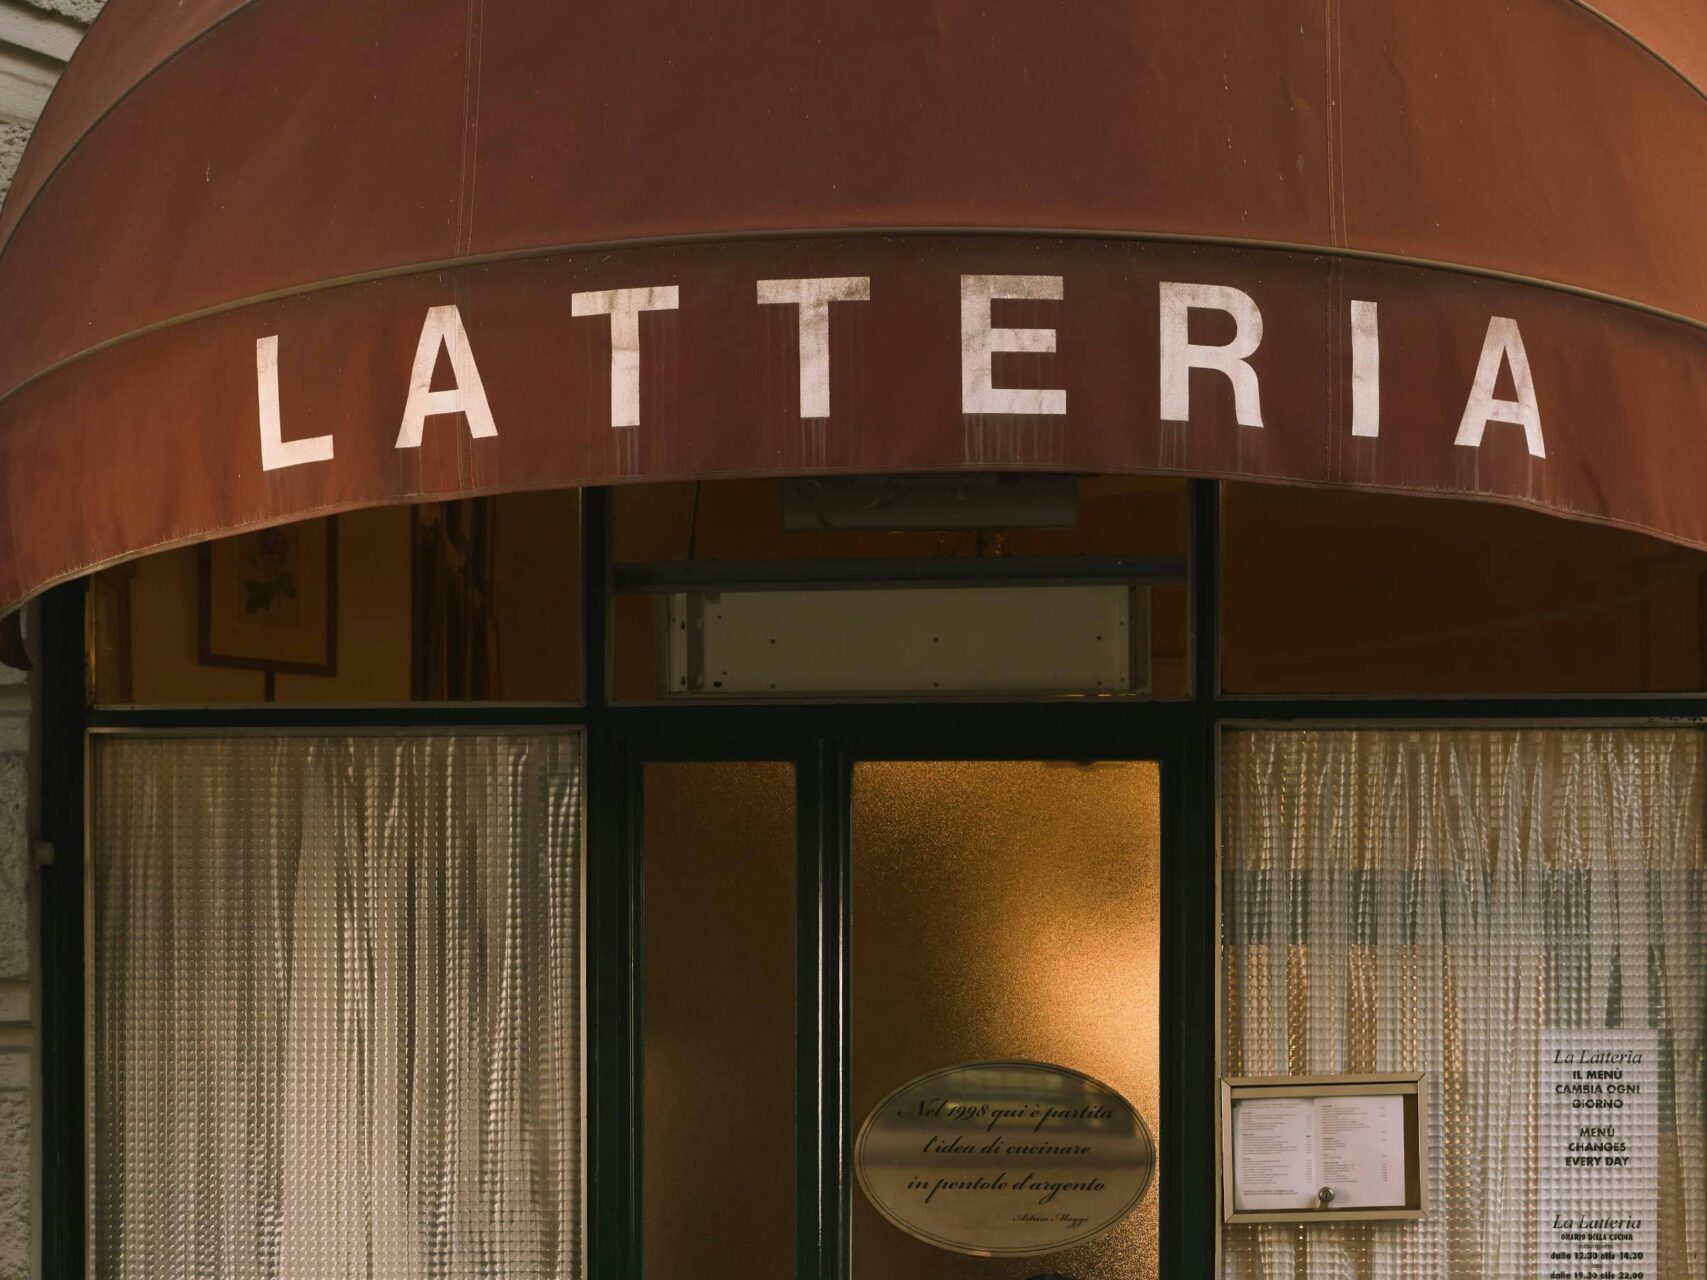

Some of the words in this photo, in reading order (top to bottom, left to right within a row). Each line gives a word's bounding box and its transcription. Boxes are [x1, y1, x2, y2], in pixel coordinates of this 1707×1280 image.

[255, 274, 1547, 472] LATTERIA
[1553, 1049, 1574, 1064] La
[1578, 1049, 1642, 1064] Latteria
[1572, 1070, 1583, 1080] IL
[1586, 1067, 1623, 1080] MENÙ
[1555, 1084, 1603, 1094] CAMBIA
[1572, 1099, 1624, 1109] GIORNO
[897, 1098, 949, 1118] Nel
[947, 1102, 988, 1120] 1998
[986, 1103, 1029, 1132] qui
[1034, 1103, 1113, 1133] partita
[922, 1135, 977, 1155] l'idea
[980, 1135, 1004, 1155] di
[1005, 1141, 1091, 1155] cucinare
[1568, 1142, 1626, 1151] CHANGES
[1565, 1156, 1602, 1166] EVERY
[1605, 1156, 1629, 1166] DAY
[907, 1176, 929, 1190] in
[924, 1172, 1008, 1204] pentole
[1012, 1172, 1106, 1205] d'argento
[1552, 1214, 1573, 1229] La
[1578, 1214, 1642, 1229] Latteria
[1560, 1233, 1586, 1241] ORARIO
[1588, 1233, 1607, 1241] DELLA
[1609, 1233, 1633, 1241] CUCINA
[1618, 1272, 1644, 1280] 22.00
